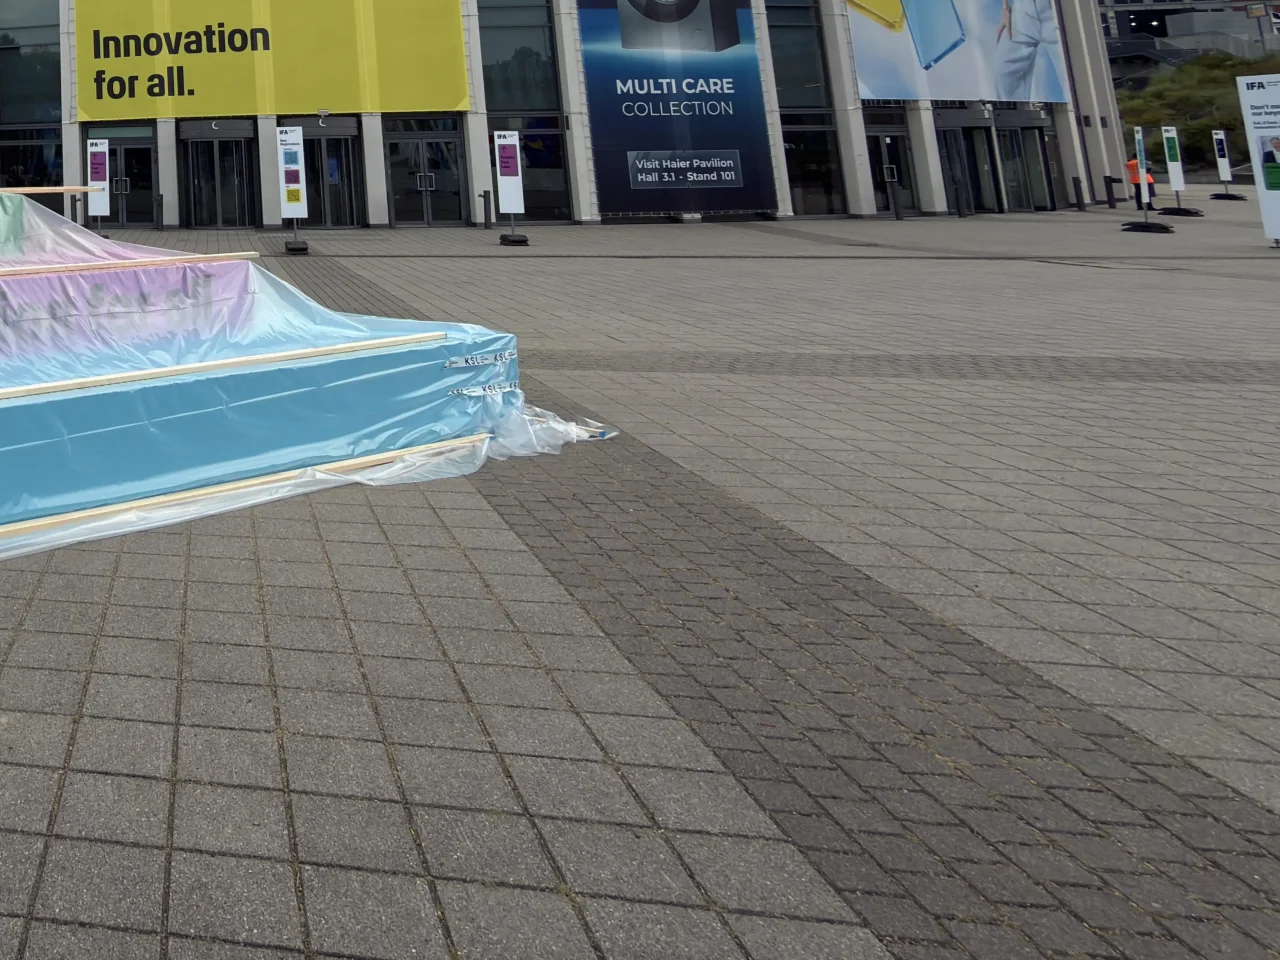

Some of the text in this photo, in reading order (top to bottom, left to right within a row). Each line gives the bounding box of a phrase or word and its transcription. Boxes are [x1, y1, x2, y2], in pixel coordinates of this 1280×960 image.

[93, 22, 270, 60] Innovation
[94, 65, 196, 100] for all.
[616, 78, 735, 95] MULTI CARE
[1245, 81, 1266, 91] IFA
[622, 101, 734, 116] COLLECTION
[635, 157, 734, 169] Visit Haier Pavilion
[637, 172, 659, 182] Hall
[662, 172, 676, 181] 3.1
[686, 171, 718, 181] Stand
[720, 171, 736, 180] 101
[464, 356, 480, 366] KSL
[493, 352, 508, 362] KSL
[481, 384, 498, 394] KSL
